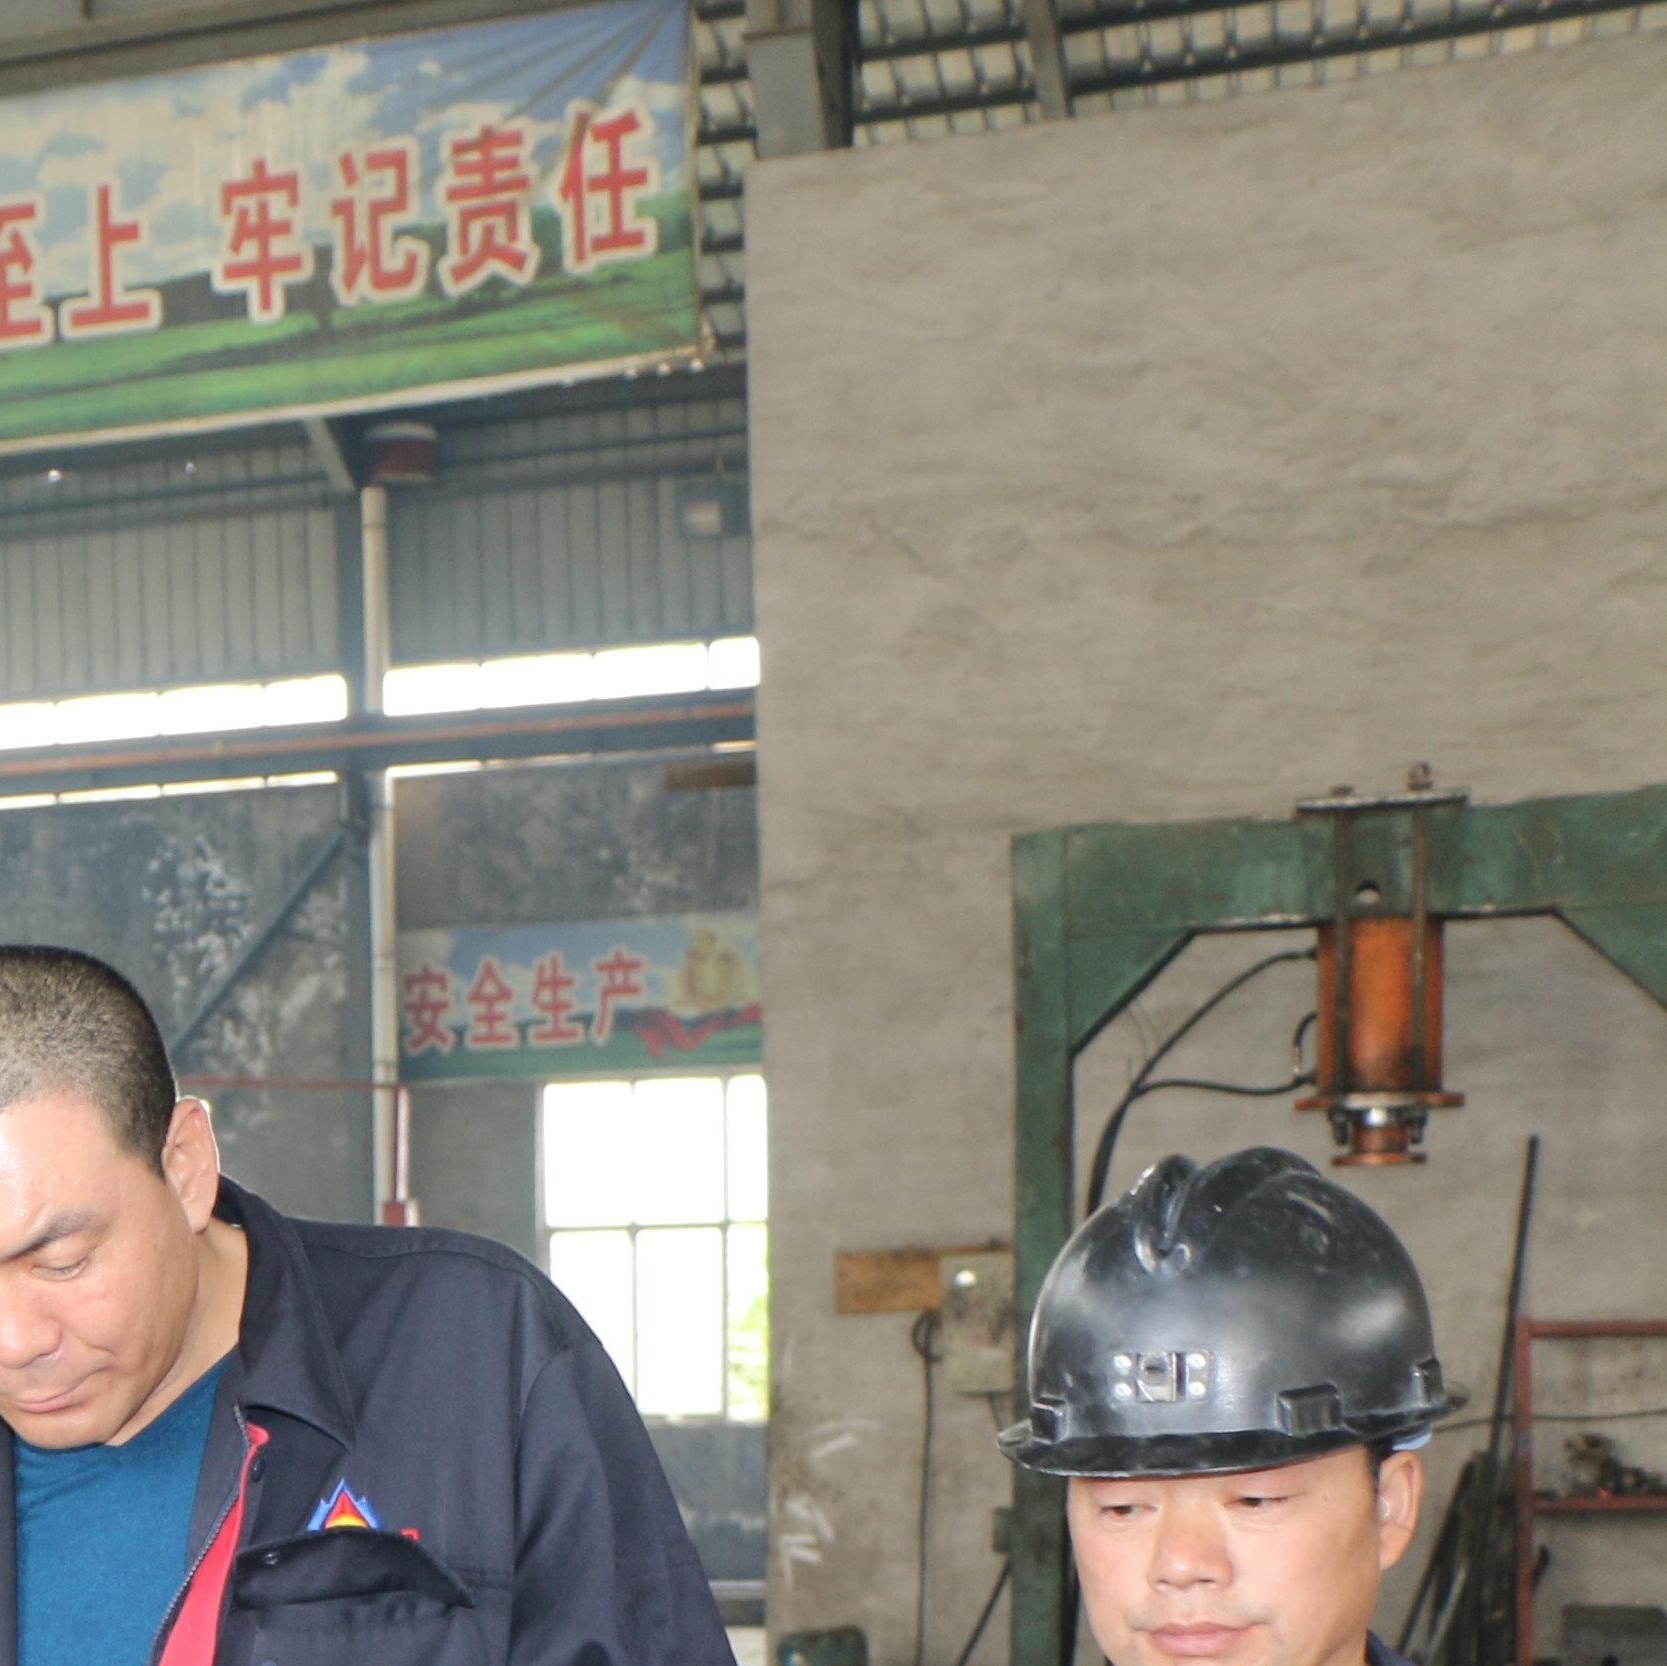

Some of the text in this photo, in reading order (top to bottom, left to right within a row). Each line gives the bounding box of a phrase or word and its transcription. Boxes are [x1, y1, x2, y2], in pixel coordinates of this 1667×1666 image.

[217, 105, 655, 318] 牢记责任
[402, 948, 645, 1053] 安全生产
